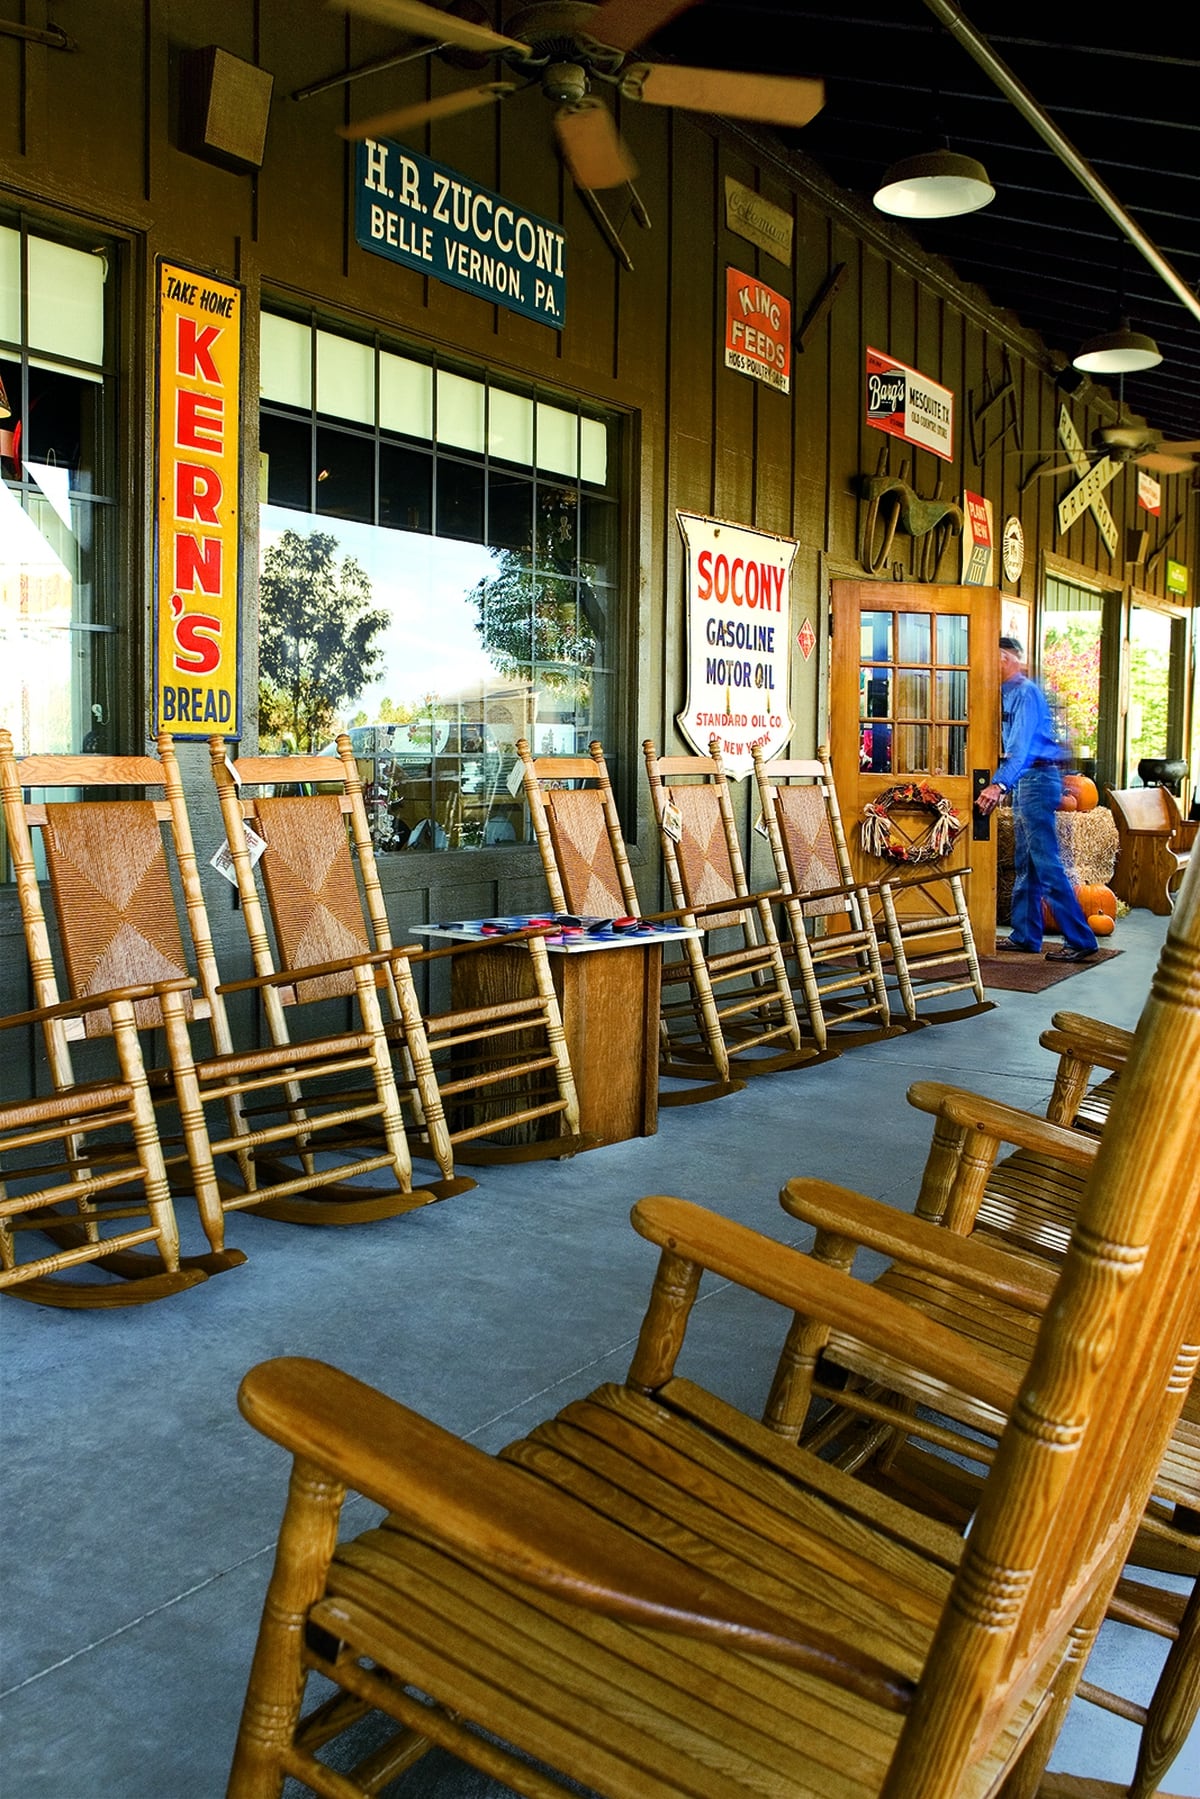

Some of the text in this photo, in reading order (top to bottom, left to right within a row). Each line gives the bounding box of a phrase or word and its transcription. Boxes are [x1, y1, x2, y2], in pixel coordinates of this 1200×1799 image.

[432, 172, 564, 279] ZUCCONI
[370, 203, 433, 262] BELLE
[535, 278, 560, 316] PA.
[166, 276, 235, 319] TAKE HOME
[738, 285, 780, 331] KING
[729, 352, 745, 369] HOGS
[731, 319, 785, 369] FEEDS
[171, 313, 226, 676] KERN'S
[697, 550, 786, 613] SOCONY
[706, 617, 775, 654] GASOLINE
[706, 657, 775, 690] MOTOR OIL
[163, 685, 231, 723] BREAD
[696, 712, 748, 728] STANDARD
[751, 714, 767, 729] OIL
[723, 740, 744, 756] NEW
